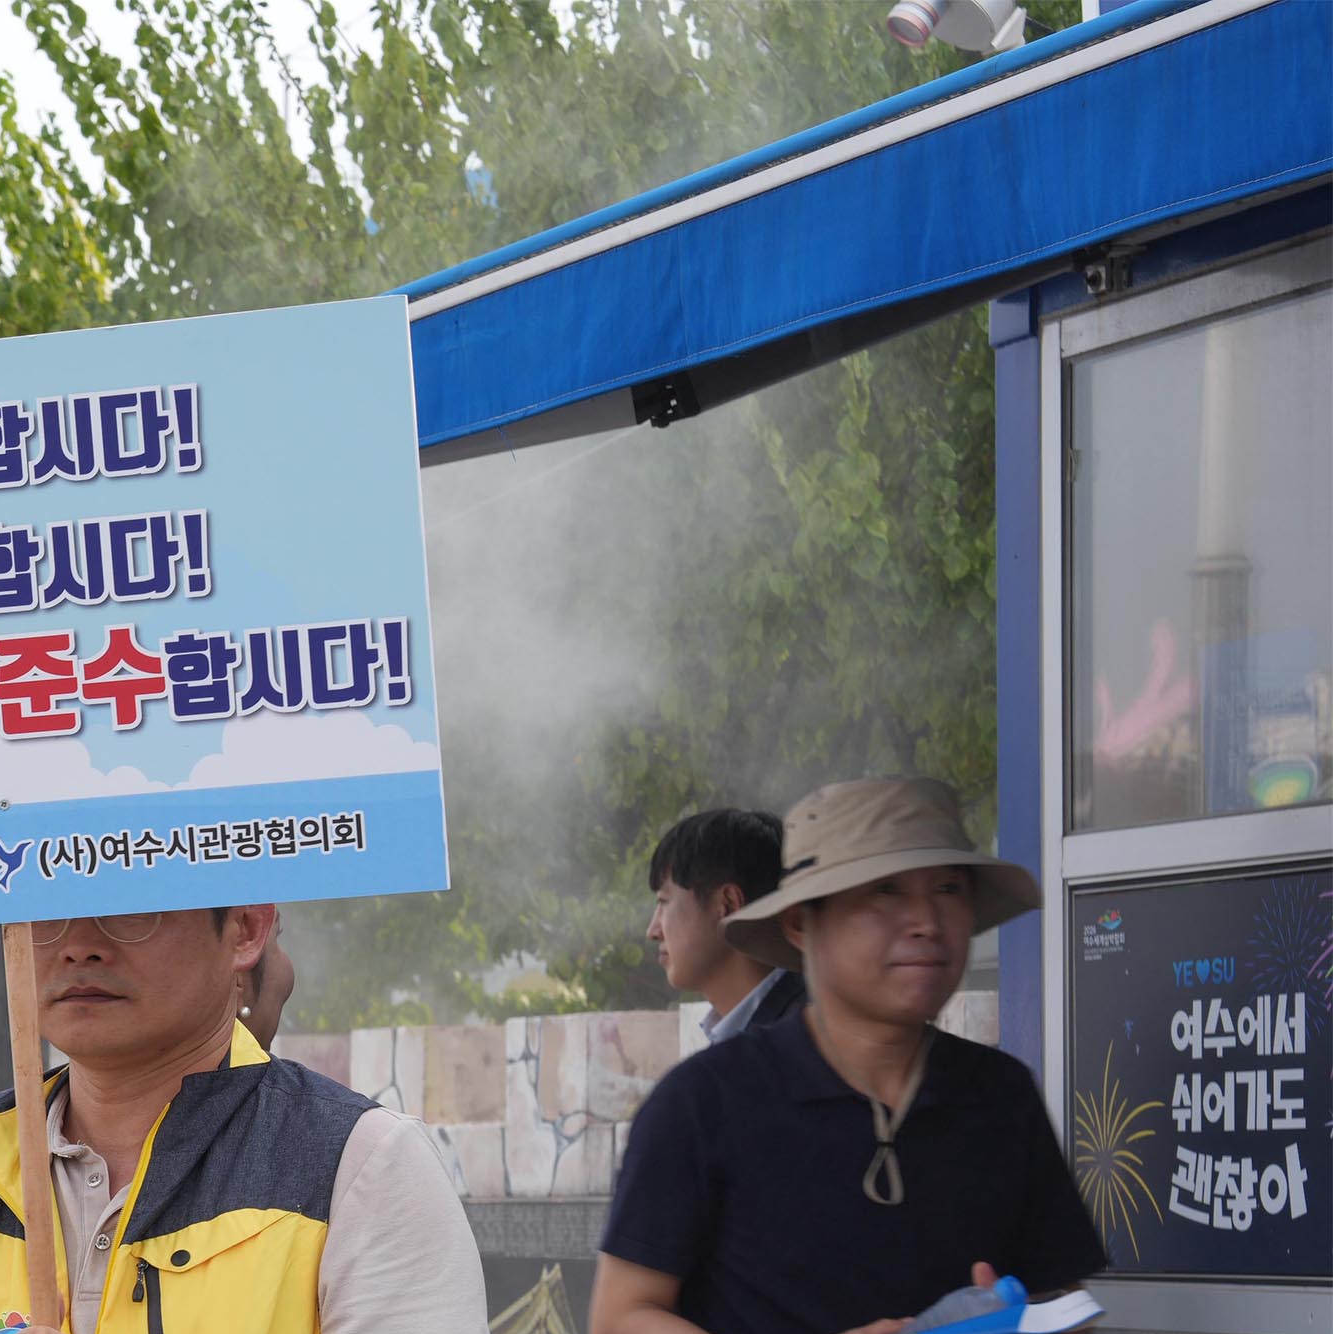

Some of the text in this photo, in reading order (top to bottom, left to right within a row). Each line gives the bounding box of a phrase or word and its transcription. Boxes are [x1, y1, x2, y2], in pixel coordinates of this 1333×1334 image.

[37, 812, 365, 879] (사)여수시관광협의회
[1171, 992, 1306, 1059] 여수에서
[1172, 1068, 1306, 1132] 쉬어가도
[1169, 1142, 1308, 1232] 괜찮아
